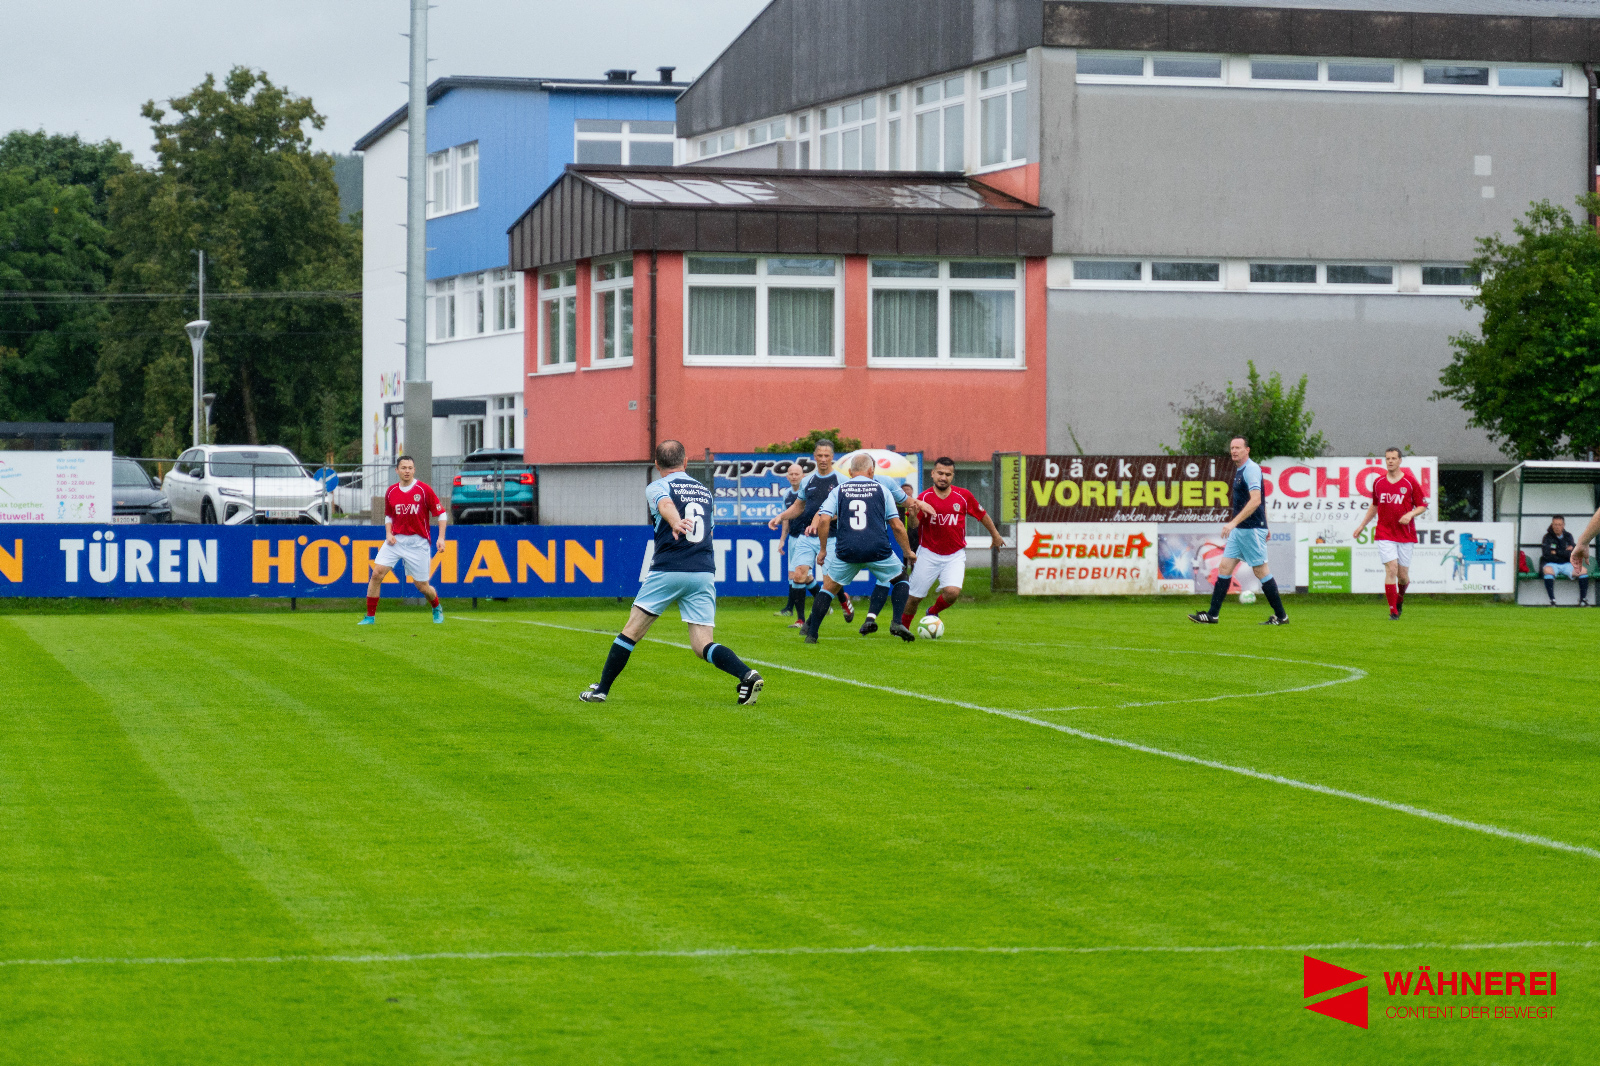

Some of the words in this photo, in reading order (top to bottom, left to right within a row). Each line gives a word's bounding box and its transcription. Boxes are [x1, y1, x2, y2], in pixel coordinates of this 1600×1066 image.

[1045, 458, 1216, 478] bäckerei
[1031, 480, 1230, 507] VORHAUER
[1379, 492, 1405, 505] EVN
[394, 503, 420, 515] EVN
[848, 499, 867, 530] 3
[1167, 508, 1230, 523] Leidenschaft
[684, 502, 705, 543] 6
[930, 513, 960, 526] EVN
[1024, 530, 1151, 559] EDTBAUER
[1054, 533, 1126, 541] METZGEREI
[59, 530, 218, 584] TÜREN
[1034, 567, 1141, 580] FRIEDBURG
